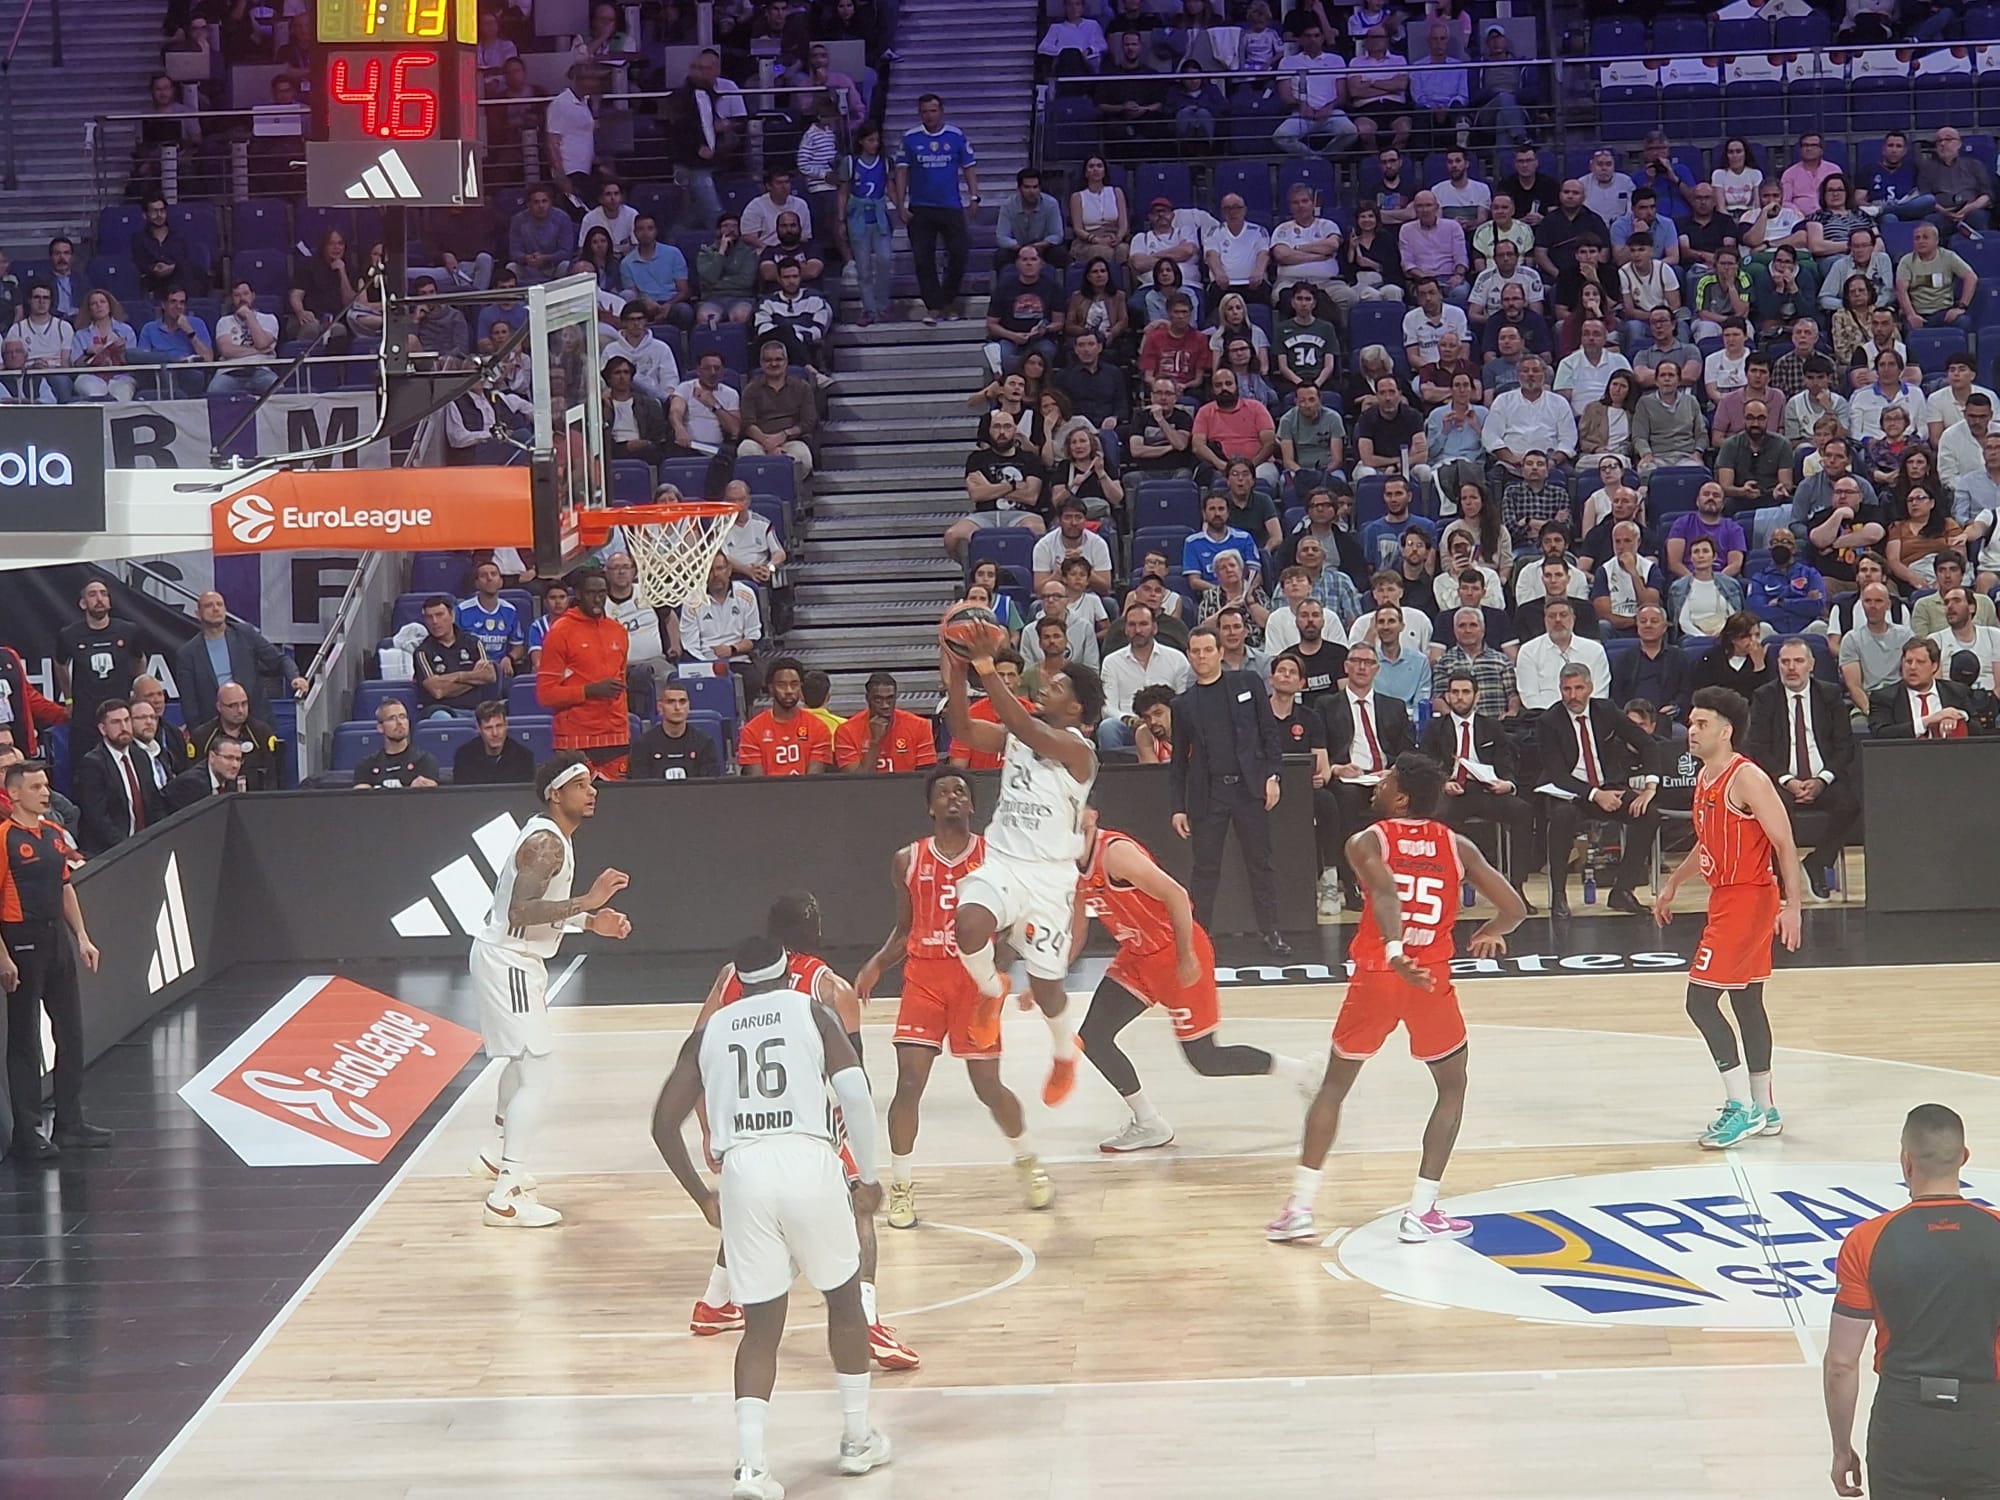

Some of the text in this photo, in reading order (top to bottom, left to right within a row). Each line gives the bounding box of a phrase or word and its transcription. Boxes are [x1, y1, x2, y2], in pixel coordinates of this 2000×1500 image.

[332, 52, 437, 139] 4.6
[1294, 347, 1317, 366] 34
[0, 445, 73, 487] ola
[282, 505, 432, 534] EuroLeague
[775, 744, 801, 765] 20
[1393, 873, 1444, 925] 25
[1035, 926, 1066, 958] 24
[1695, 947, 1713, 972] 3
[731, 1012, 782, 1032] GARUBA
[304, 1009, 437, 1098] EuroLeague
[728, 1037, 788, 1099] 16
[734, 1110, 794, 1133] MADRID
